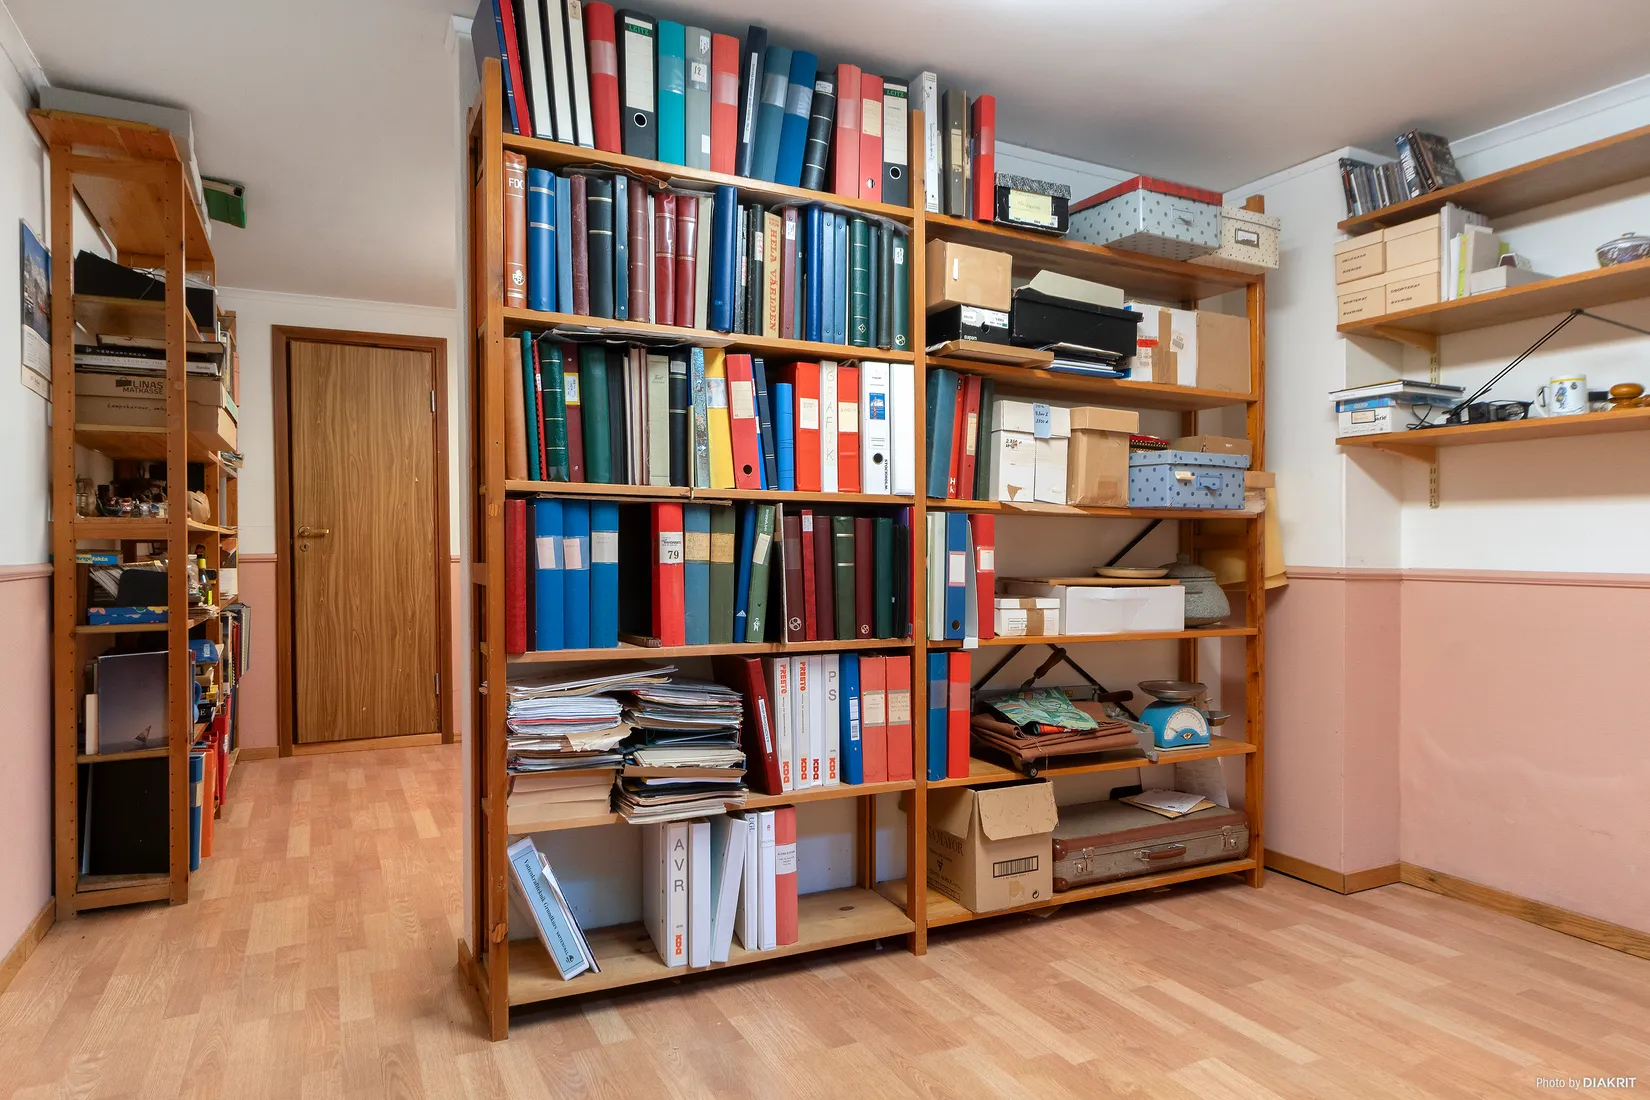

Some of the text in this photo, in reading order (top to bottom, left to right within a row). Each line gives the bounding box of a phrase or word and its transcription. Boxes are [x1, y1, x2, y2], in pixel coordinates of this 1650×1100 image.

[629, 24, 649, 35] LEITZ
[886, 89, 905, 98] LEITZ
[508, 177, 524, 190] FDC
[770, 228, 778, 263] HELA
[769, 268, 778, 332] VÄRLDEN
[132, 380, 164, 389] LINAS
[122, 387, 164, 395] MATKASSE
[667, 550, 680, 560] 79
[542, 901, 558, 931] Grundkurs
[556, 930, 569, 956] VATTENFALL
